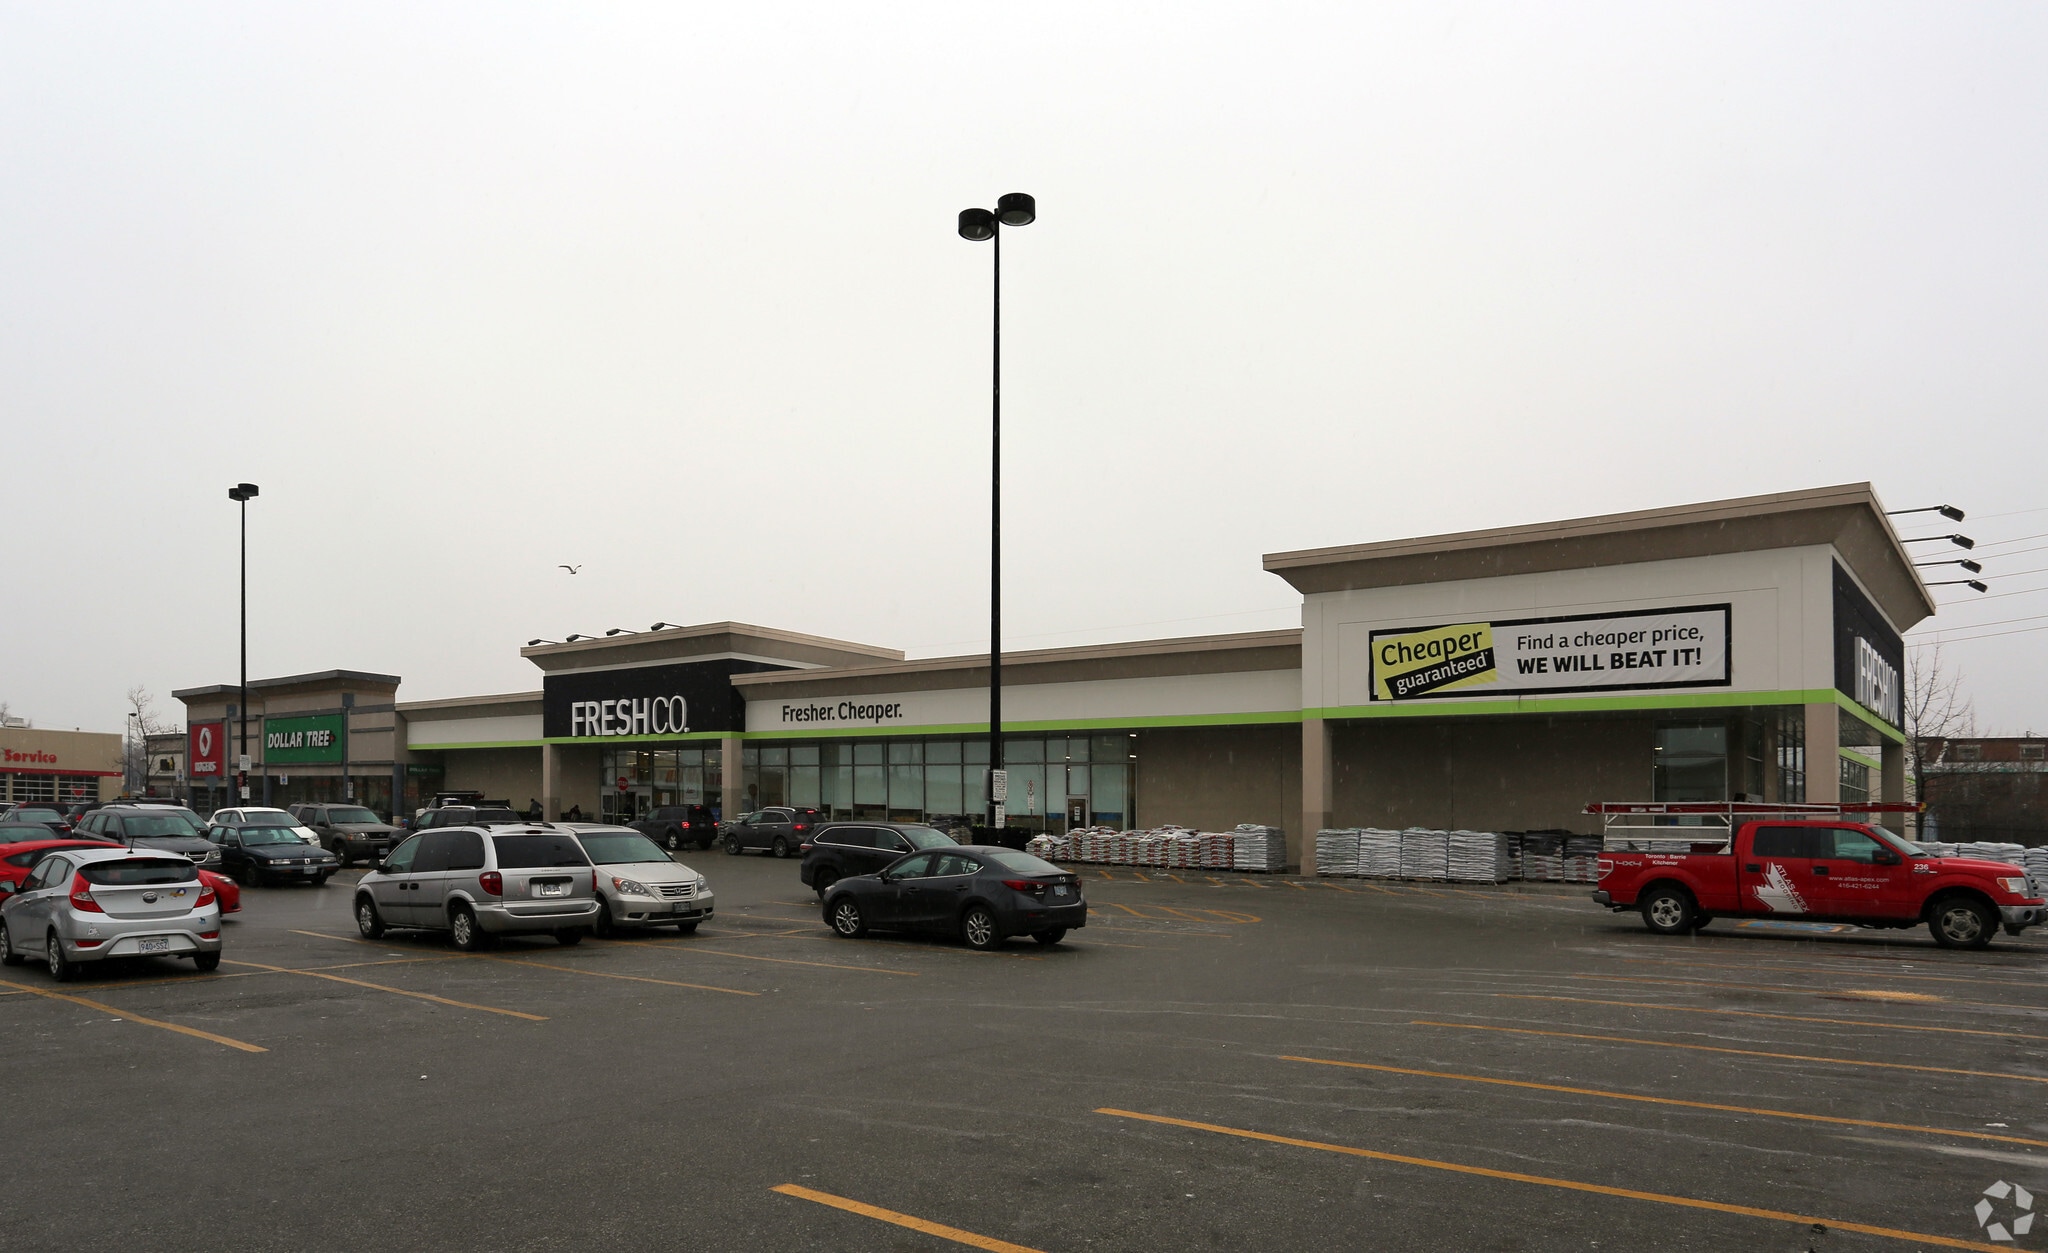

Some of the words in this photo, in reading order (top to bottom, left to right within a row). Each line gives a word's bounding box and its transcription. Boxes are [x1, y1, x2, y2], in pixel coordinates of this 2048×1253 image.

[1381, 631, 1482, 666] Cheaper
[1517, 634, 1554, 650] Find
[1559, 636, 1569, 648] a
[1574, 630, 1646, 648] cheaper
[1652, 625, 1704, 646] price,
[1517, 657, 1548, 675] WE
[1553, 654, 1604, 672] WILL
[1610, 650, 1667, 670] BEAT
[1673, 647, 1702, 666] IT!
[782, 704, 835, 722] Fresher.
[838, 701, 902, 724] Cheaper.
[267, 731, 303, 749] DOLLAR
[306, 729, 331, 747] TREE
[4, 748, 57, 763] Service
[1775, 864, 1810, 913] ATLAS-APEX
[1829, 875, 1890, 884] www.atlas-apex.com
[1777, 879, 1799, 910] ROOFING
